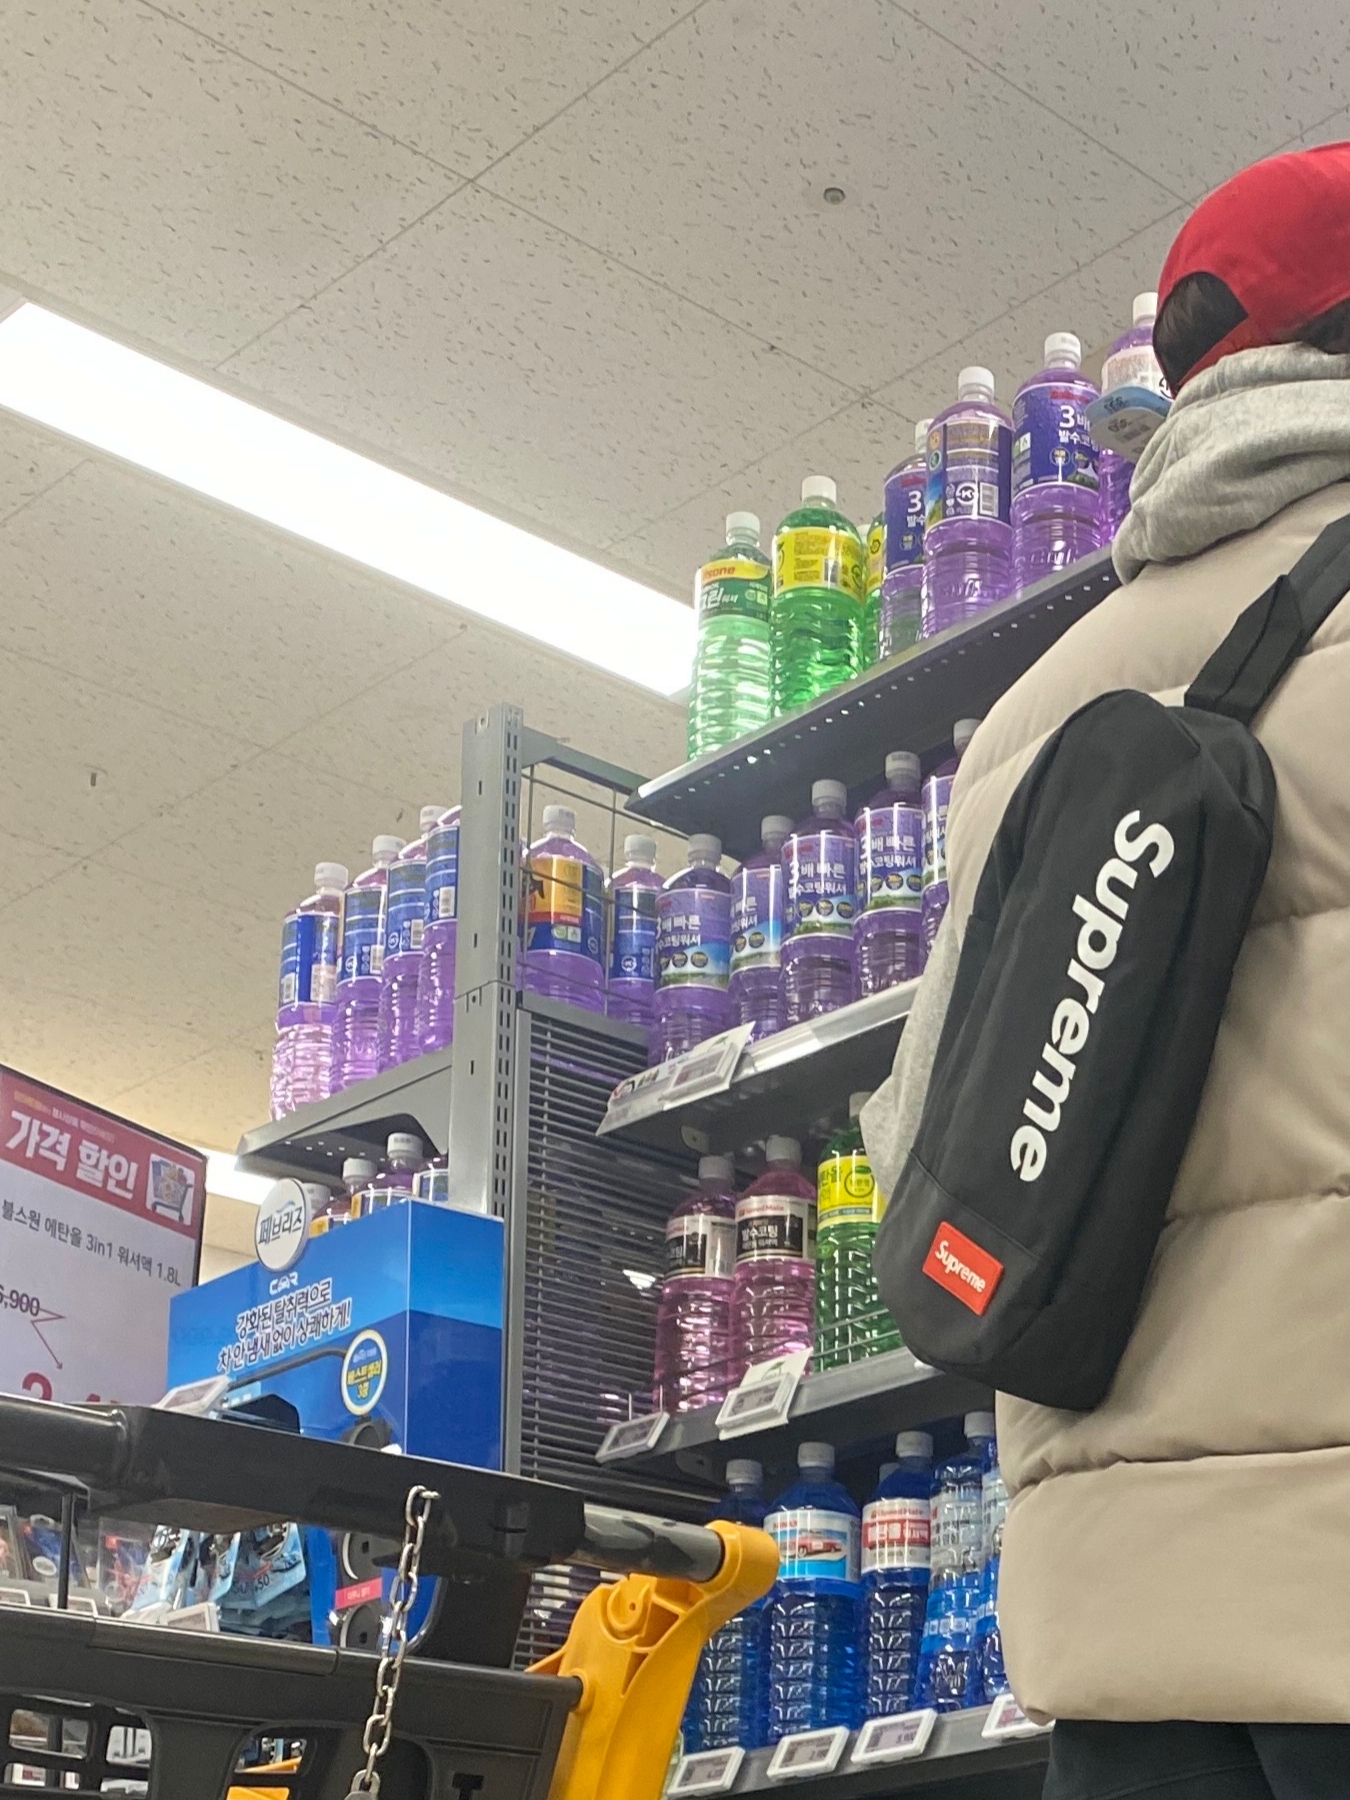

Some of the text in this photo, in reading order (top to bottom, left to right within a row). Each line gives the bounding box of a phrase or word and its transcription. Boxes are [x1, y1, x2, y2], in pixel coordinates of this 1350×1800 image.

[1010, 809, 1175, 1183] Supreme
[5, 1110, 71, 1171] 가격
[76, 1139, 139, 1200] 할인
[44, 1216, 83, 1248] 에탄올
[86, 1233, 114, 1260] 3in1
[117, 1246, 154, 1277] 워셔액
[156, 1262, 181, 1287] 1.8L
[258, 1206, 303, 1246] 페브리즈
[269, 1271, 299, 1296] CAR
[934, 1239, 987, 1296] Supreme
[237, 1278, 333, 1340] 강화된 탈취력으로
[298, 1298, 352, 1345] 상쾌하게!
